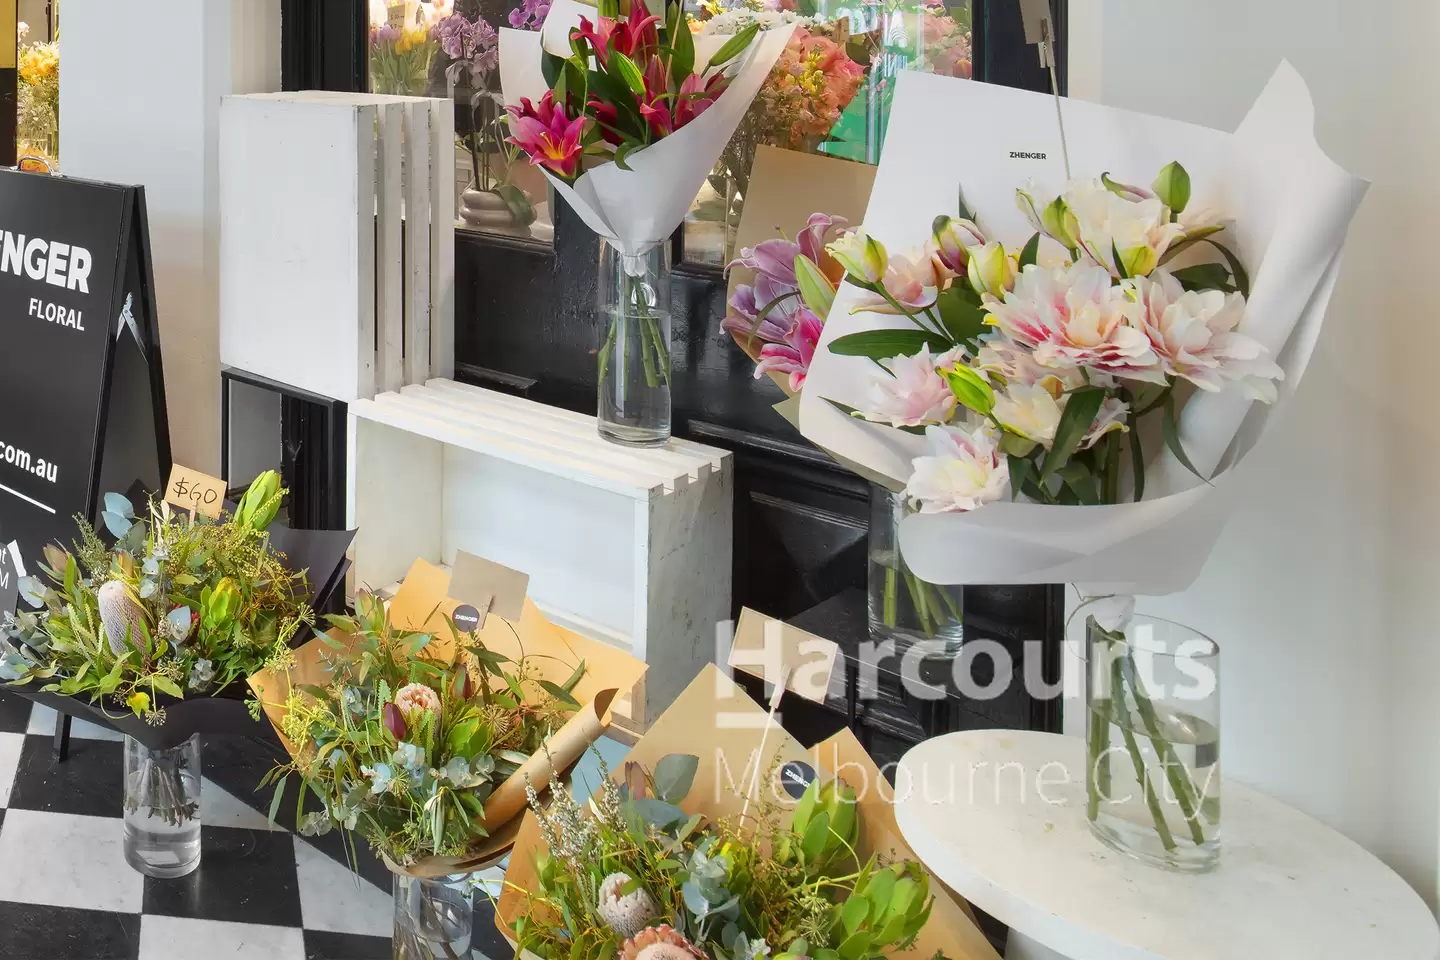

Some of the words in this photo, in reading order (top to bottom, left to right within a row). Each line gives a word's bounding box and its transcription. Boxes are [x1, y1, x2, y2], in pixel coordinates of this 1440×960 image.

[1009, 151, 1047, 160] ZHENGER
[29, 297, 85, 331] FLORAL
[172, 476, 218, 504] $60
[784, 768, 811, 788] ZHENG
